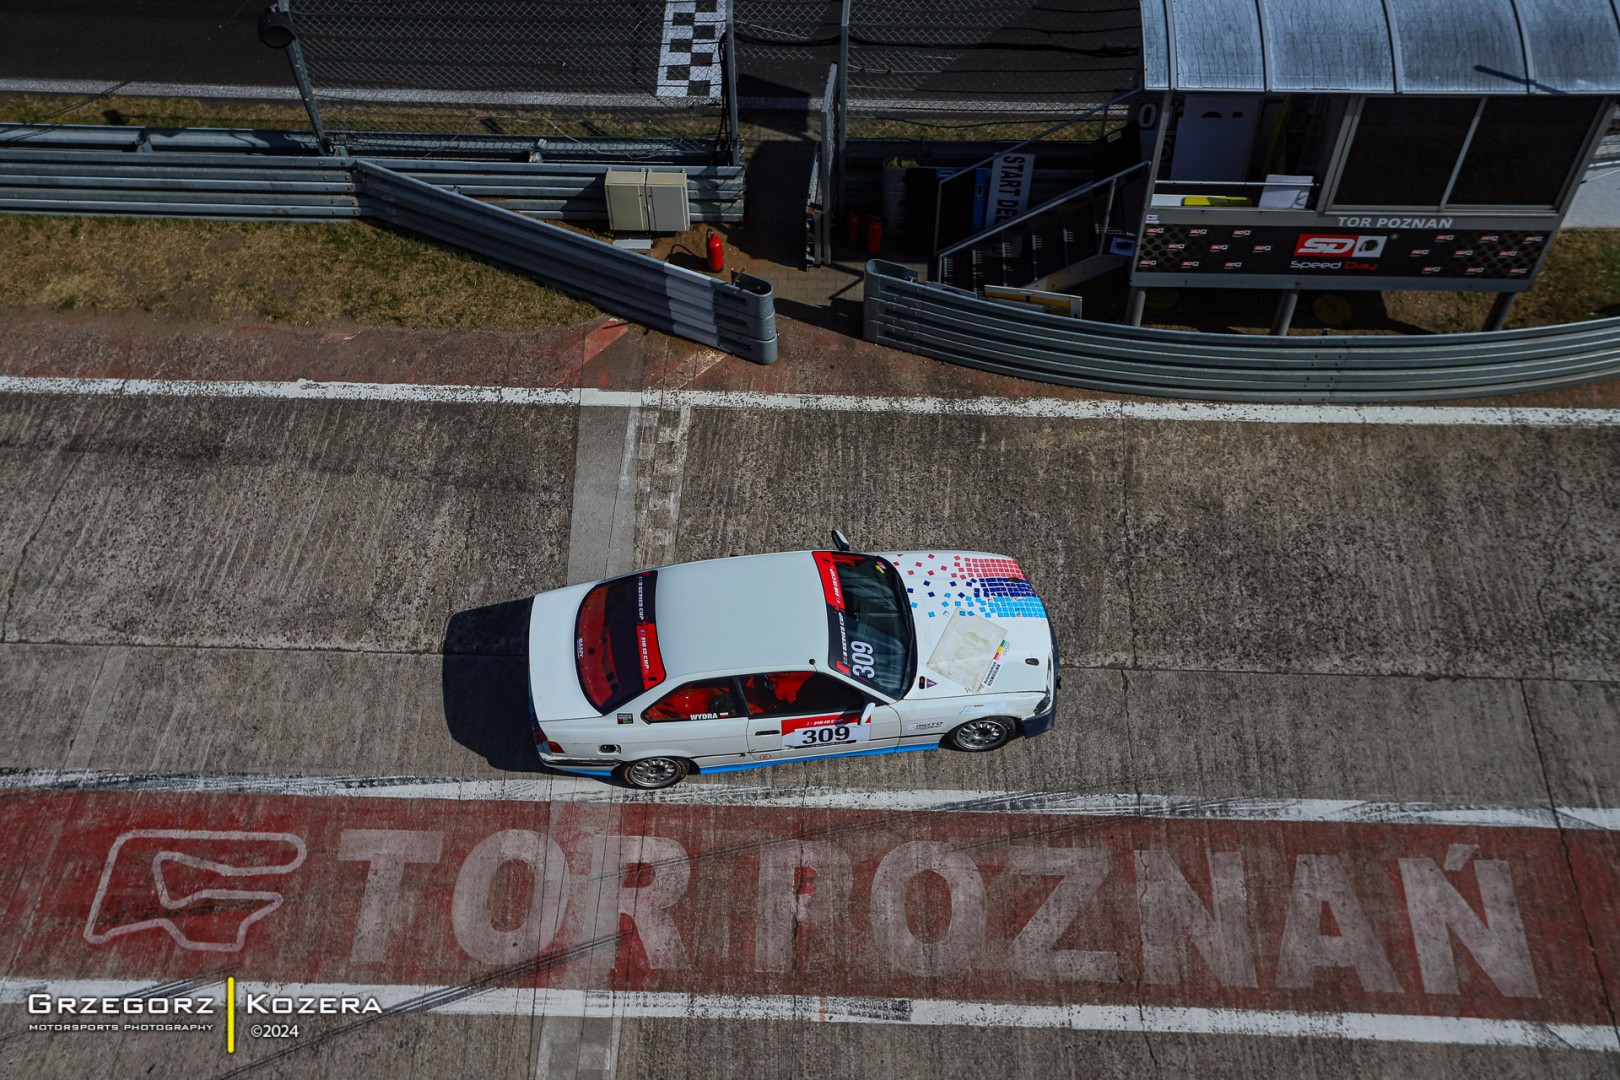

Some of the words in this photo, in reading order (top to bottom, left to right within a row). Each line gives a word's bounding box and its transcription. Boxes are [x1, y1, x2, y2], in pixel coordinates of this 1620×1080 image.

[999, 156, 1026, 197] START
[1338, 216, 1372, 227] TOR
[1376, 217, 1453, 229] POZNAŃ
[1297, 237, 1356, 254] SD
[1289, 260, 1343, 270] Speed
[1343, 261, 1377, 271] Day
[851, 640, 875, 679] 309
[690, 713, 718, 721] WYDRA
[802, 726, 850, 744] 309
[339, 829, 691, 972] TOR
[755, 840, 1543, 999] POZNAŃ
